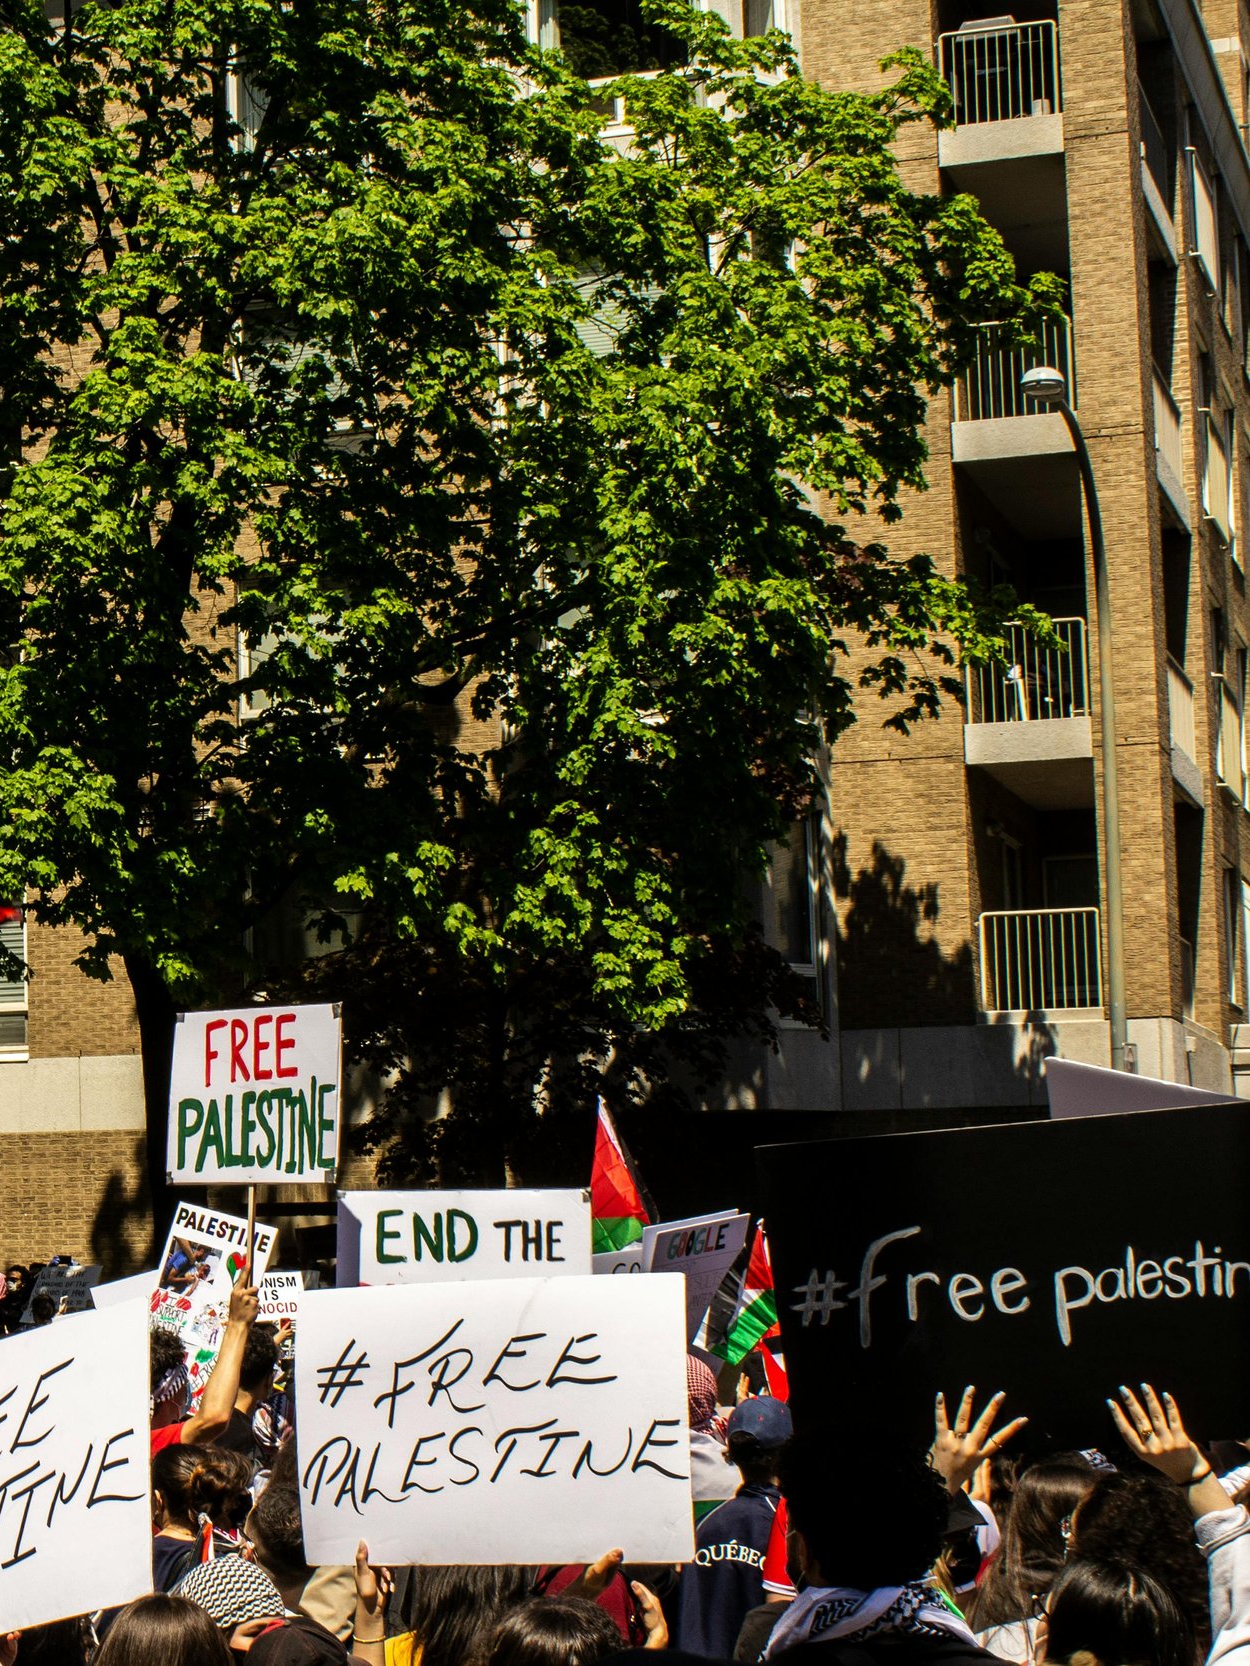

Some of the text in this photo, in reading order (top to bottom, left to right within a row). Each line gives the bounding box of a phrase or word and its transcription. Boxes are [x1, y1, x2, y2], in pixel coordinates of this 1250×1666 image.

[205, 1013, 298, 1088] FREE
[177, 1075, 336, 1175] PALESTINE
[377, 1208, 566, 1264] END THE
[667, 1223, 730, 1260] GOOGLE
[259, 1301, 298, 1315] NOCID
[260, 1276, 297, 1289] NISM
[264, 1289, 279, 1301] IS
[316, 1318, 618, 1428] #FREE
[303, 1418, 689, 1516] PALESTINE
